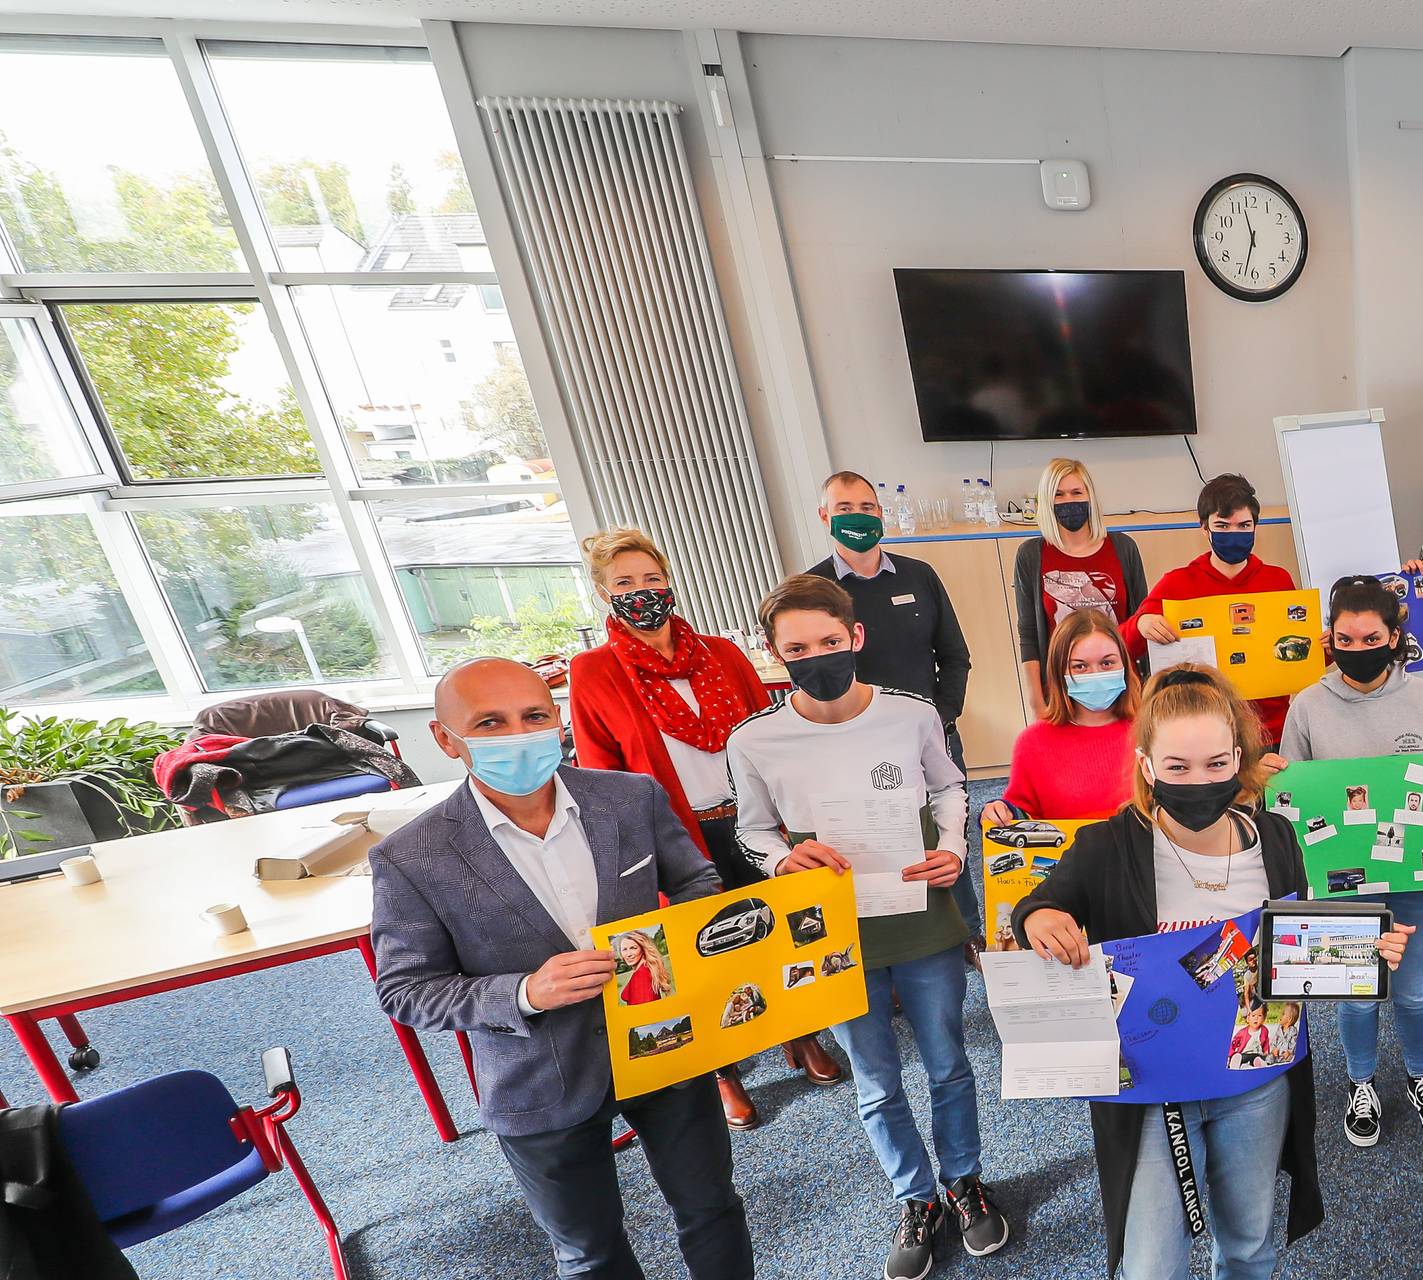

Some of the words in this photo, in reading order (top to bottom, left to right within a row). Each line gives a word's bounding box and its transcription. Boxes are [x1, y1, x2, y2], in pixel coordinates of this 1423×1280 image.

[1230, 201, 1241, 214] 11
[1244, 195, 1258, 209] 12
[1264, 200, 1270, 214] 1
[1219, 215, 1233, 229] 10
[1275, 212, 1284, 226] 2
[1214, 231, 1224, 244] 9
[1283, 231, 1291, 245] 3
[1221, 249, 1231, 262] 8
[1277, 249, 1287, 262] 4
[1235, 262, 1244, 275] 7
[1250, 266, 1260, 280] 6
[1268, 262, 1276, 276] 5
[1166, 1111, 1189, 1178] KANGOL
[1181, 1178, 1203, 1232] KANGO
